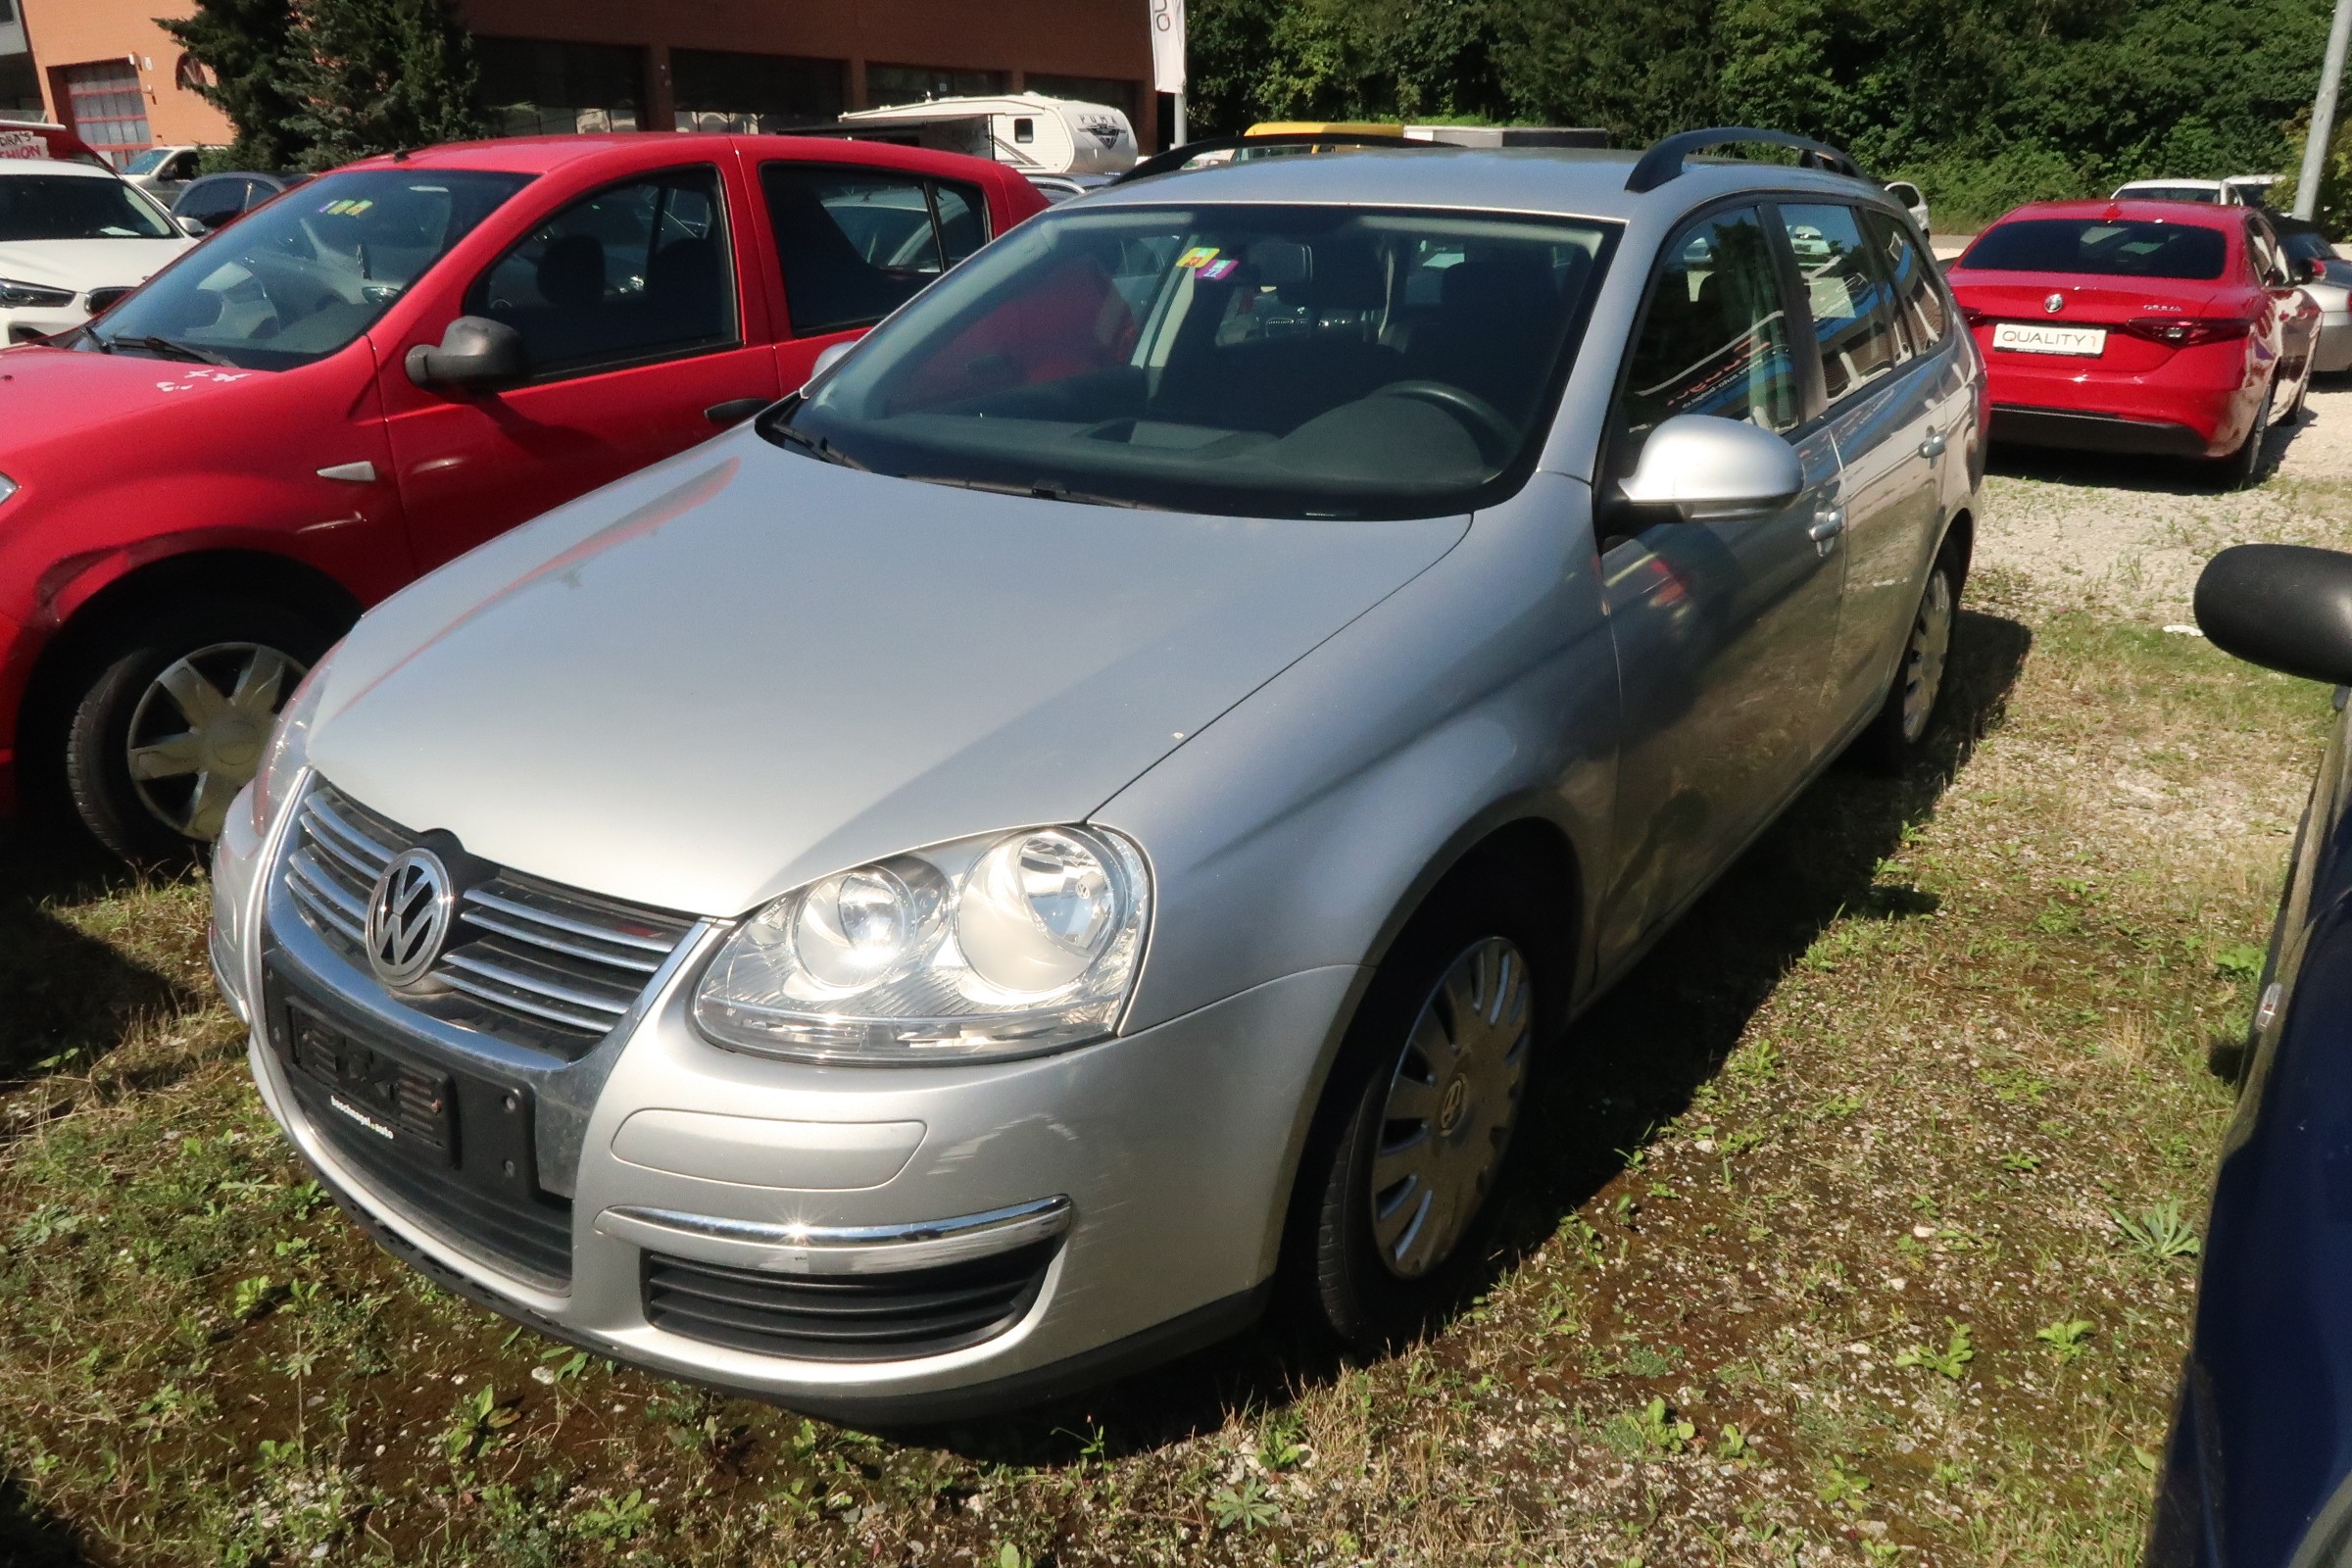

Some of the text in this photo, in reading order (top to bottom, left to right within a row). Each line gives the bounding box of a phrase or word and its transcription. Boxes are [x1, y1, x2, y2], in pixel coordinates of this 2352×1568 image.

[1079, 114, 1118, 124] PUMA
[2002, 330, 2096, 347] QUALITY 1
